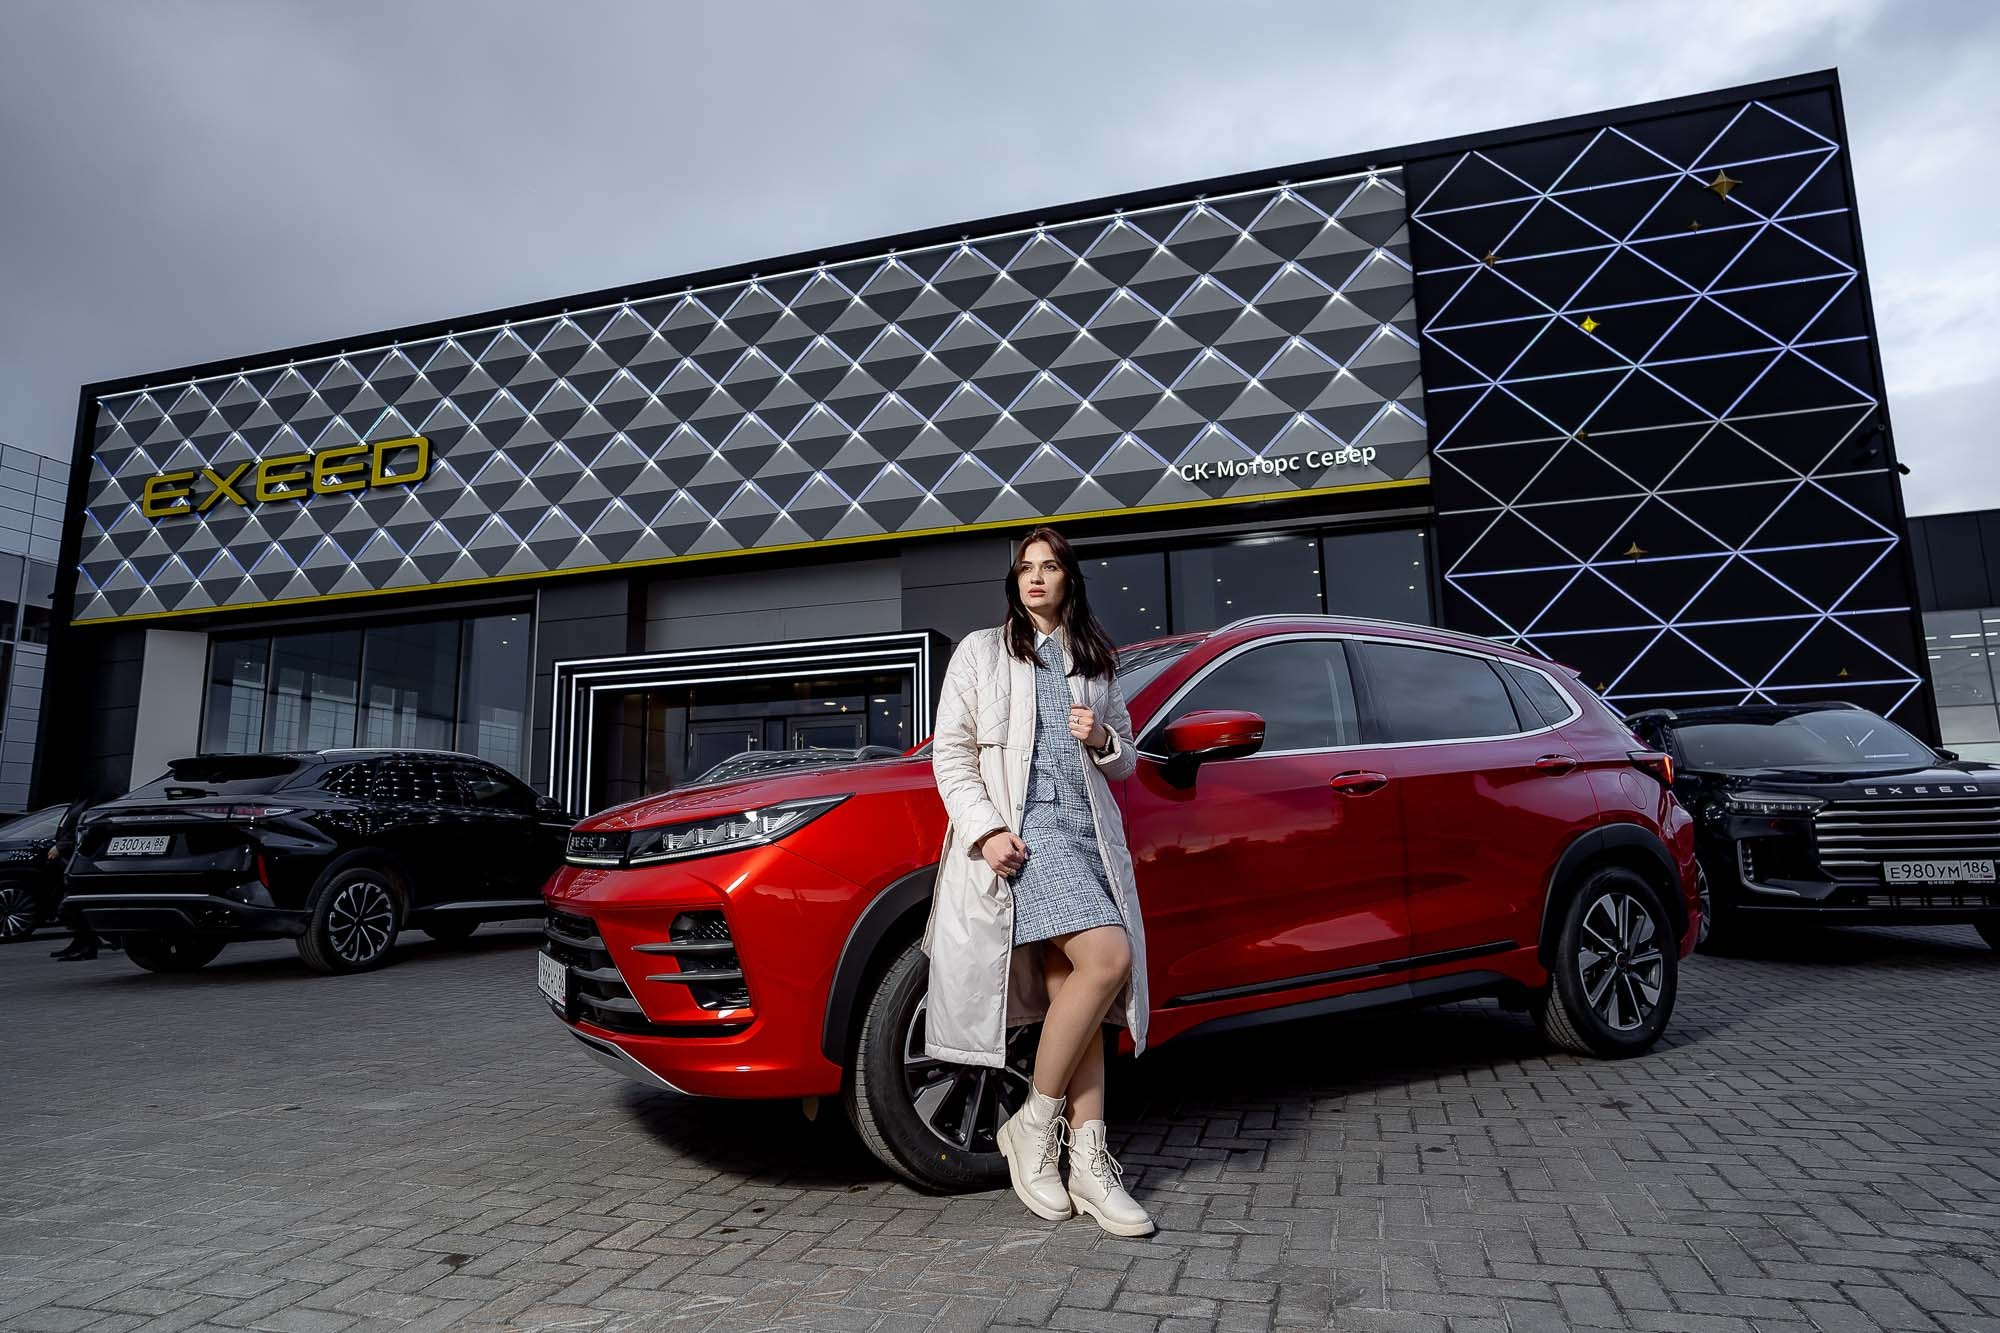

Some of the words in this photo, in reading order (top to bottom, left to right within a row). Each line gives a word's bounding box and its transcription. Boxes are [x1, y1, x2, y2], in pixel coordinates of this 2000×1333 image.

[142, 436, 429, 518] EXEED
[1180, 455, 1300, 482] СК-Моторс
[1305, 446, 1377, 469] Север
[1864, 785, 1979, 795] EXEED
[1890, 863, 1961, 879] Е980УМ
[1963, 862, 1990, 874] 186
